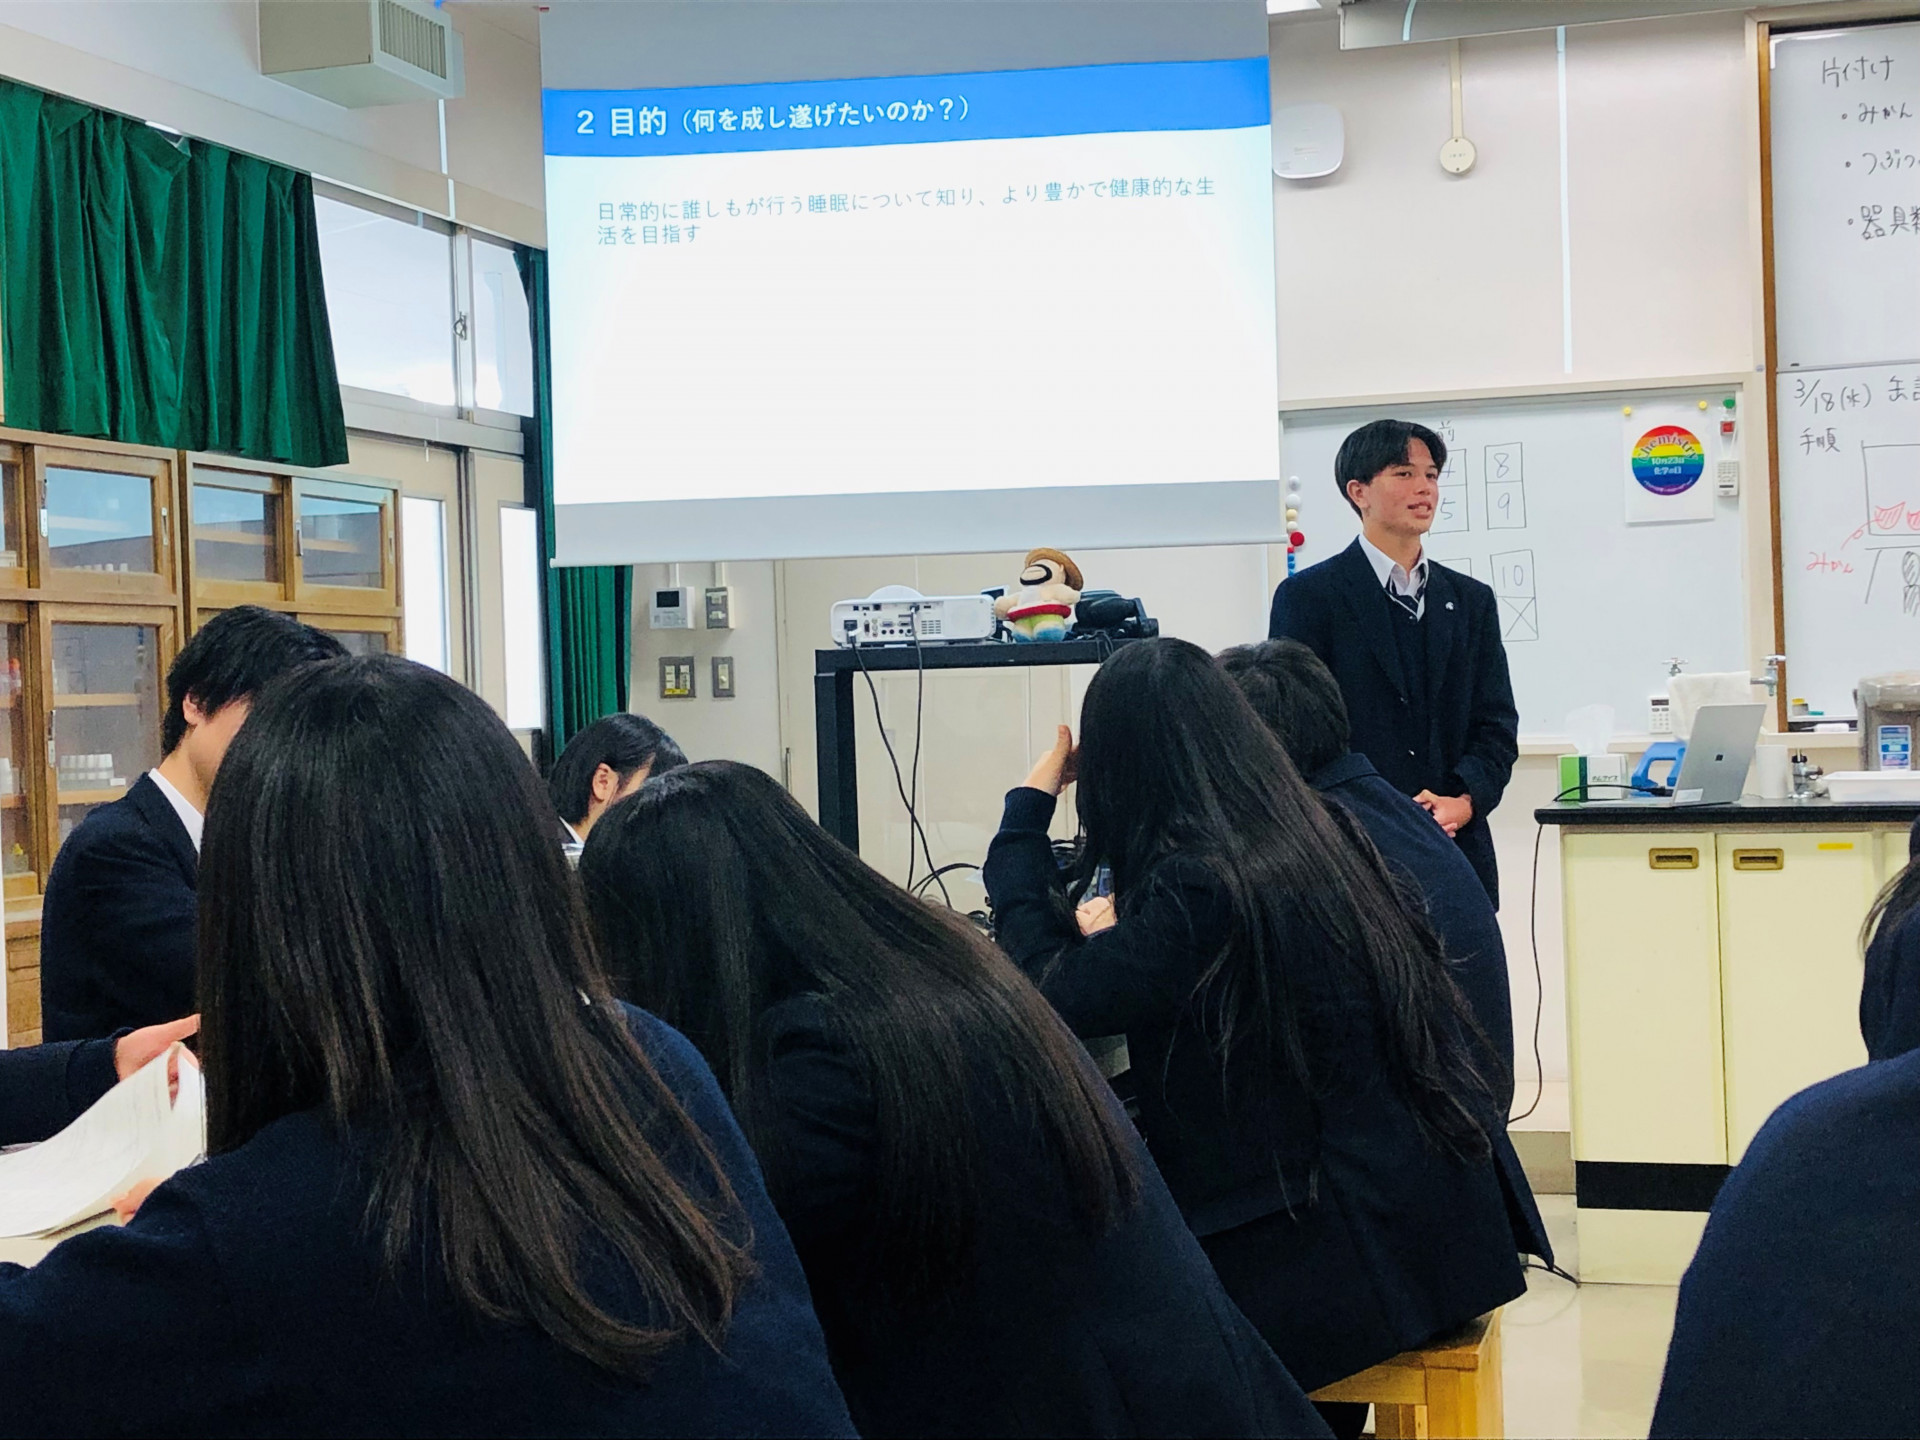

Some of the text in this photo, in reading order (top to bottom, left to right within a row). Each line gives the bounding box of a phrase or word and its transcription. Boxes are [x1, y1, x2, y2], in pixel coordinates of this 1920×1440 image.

[1822, 55, 1895, 88] 片付け
[576, 110, 594, 134] 2
[1858, 102, 1912, 125] みかん
[1862, 148, 1920, 175] つぶつ
[598, 176, 1216, 222] 日常的に誰しもが行う睡眠について知り、より豊かで健康的な生
[598, 224, 701, 245] 活を目指す
[1638, 432, 1699, 463] Chemistry
[1800, 427, 1840, 456] 手順
[1493, 452, 1510, 479] 8
[1440, 492, 1510, 520] 5 9
[1806, 551, 1854, 574] みかん
[1502, 564, 1524, 589] 10
